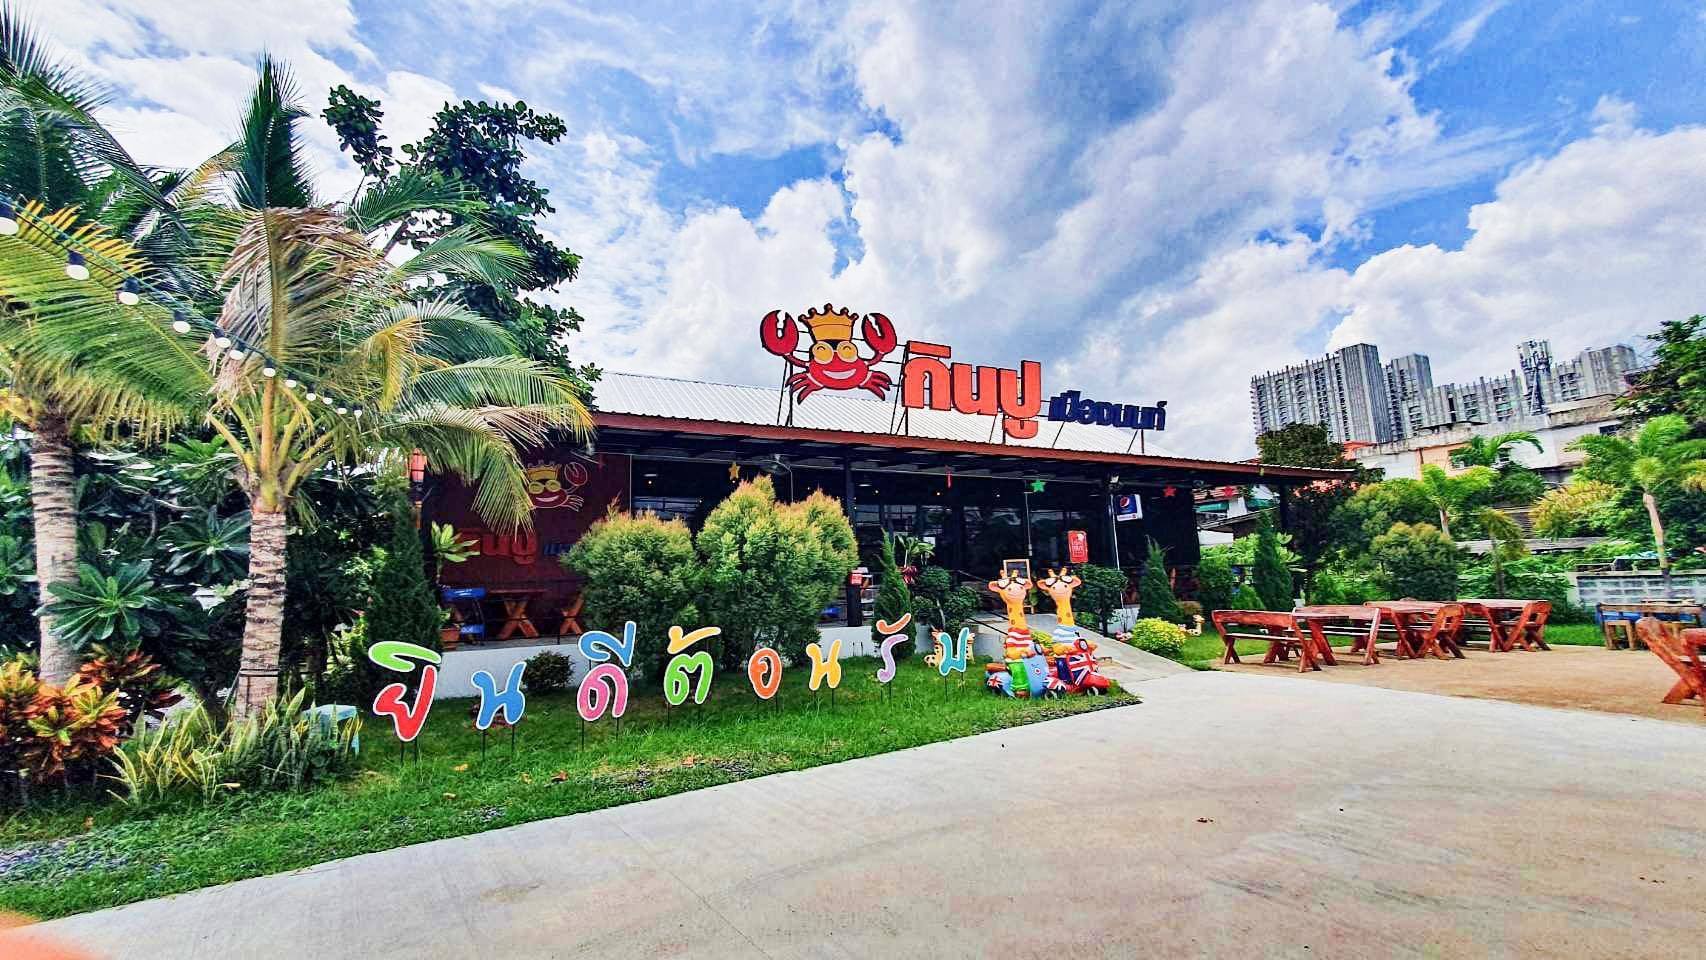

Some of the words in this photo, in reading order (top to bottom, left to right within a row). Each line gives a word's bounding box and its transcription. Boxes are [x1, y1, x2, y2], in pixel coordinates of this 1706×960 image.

[902, 341, 1042, 439] กินปู
[1048, 390, 1167, 431] เมืองนนท์
